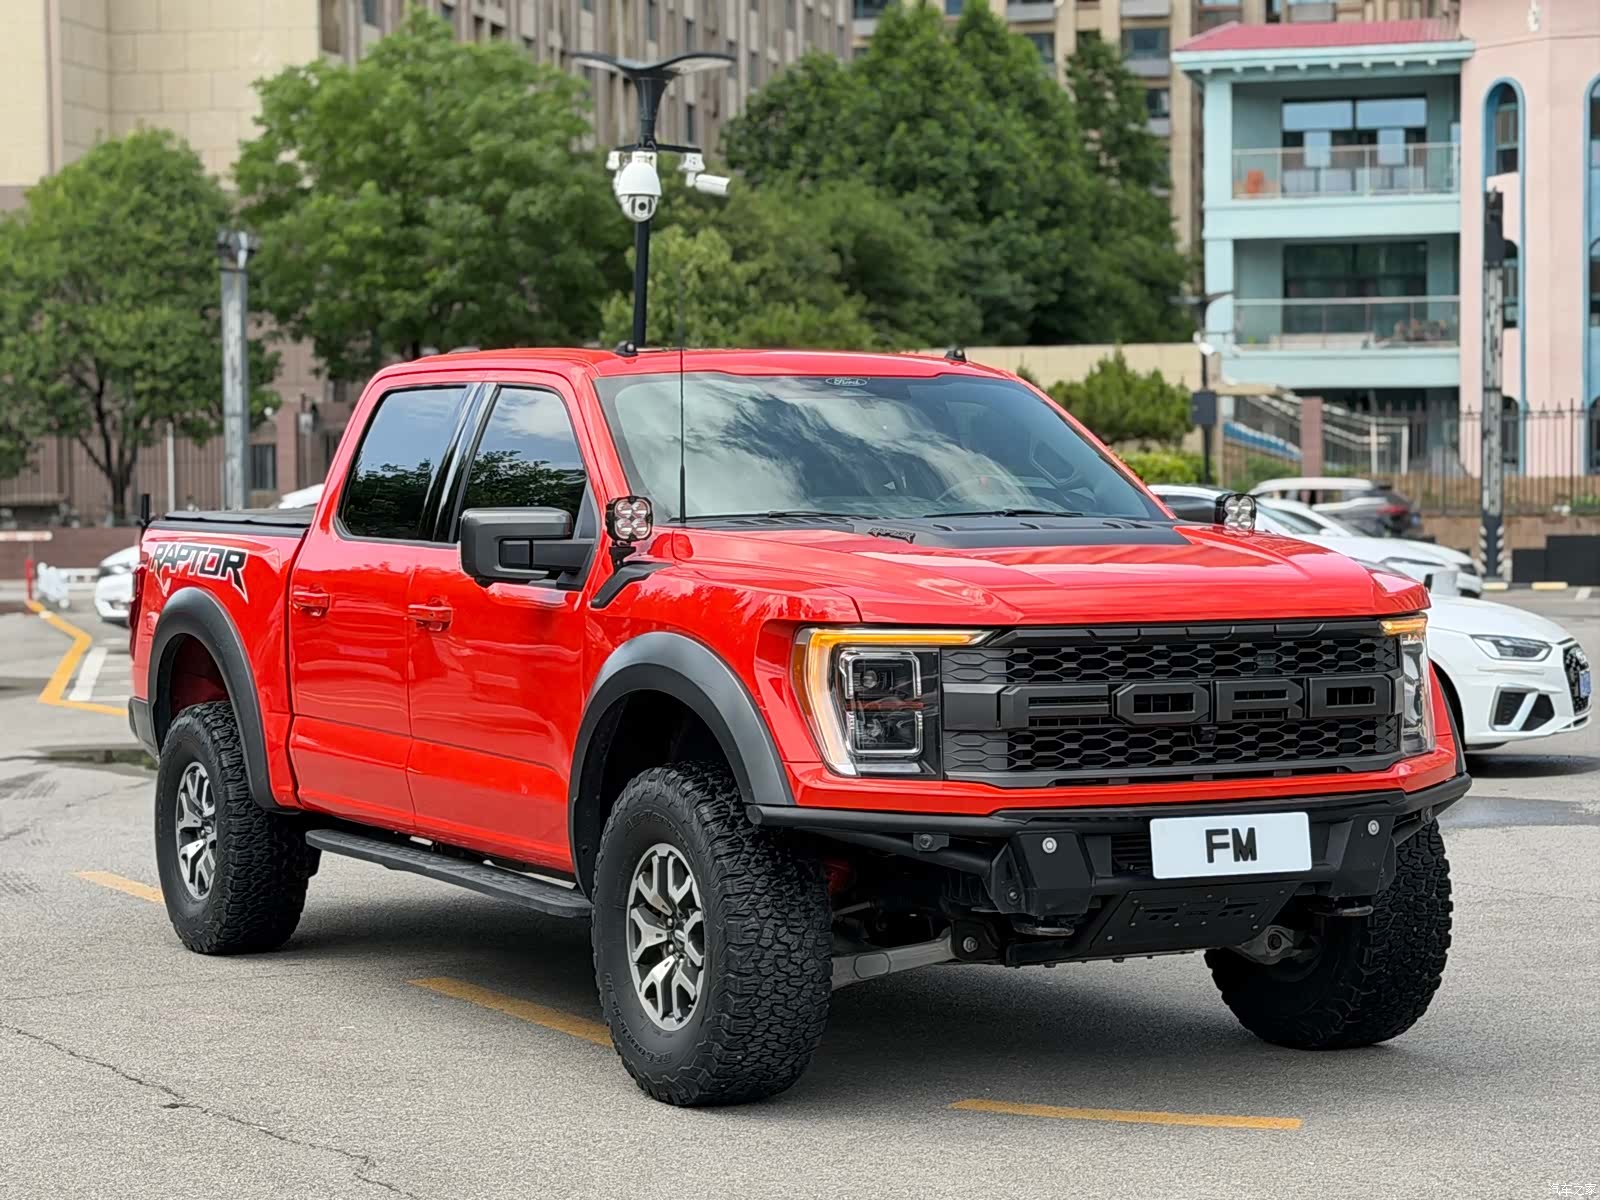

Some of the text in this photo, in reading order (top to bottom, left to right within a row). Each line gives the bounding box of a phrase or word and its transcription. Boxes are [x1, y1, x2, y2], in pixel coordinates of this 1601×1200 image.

[149, 542, 248, 604] RAPTOR
[1001, 674, 1397, 731] FORD
[1205, 827, 1258, 864] FM
